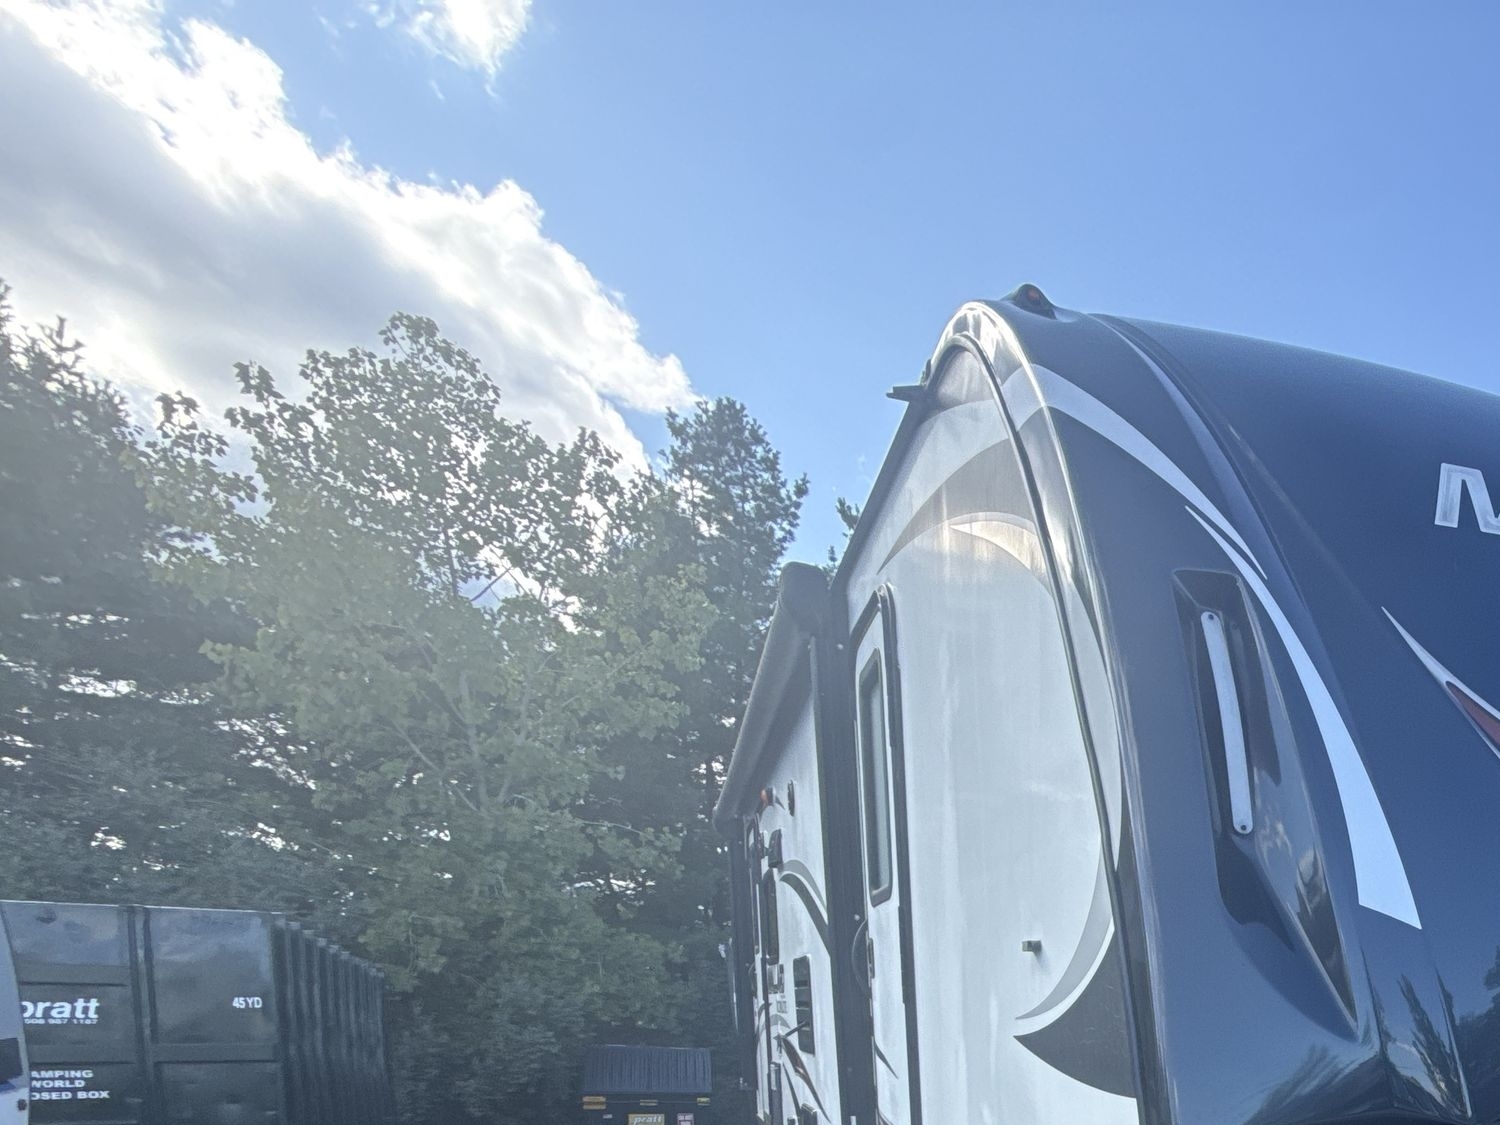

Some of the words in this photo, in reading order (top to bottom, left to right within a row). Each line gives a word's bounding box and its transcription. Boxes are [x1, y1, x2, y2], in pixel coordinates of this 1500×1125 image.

[31, 1070, 94, 1078] AMPING
[77, 1090, 110, 1099] BOX
[633, 1114, 662, 1125] pratt
